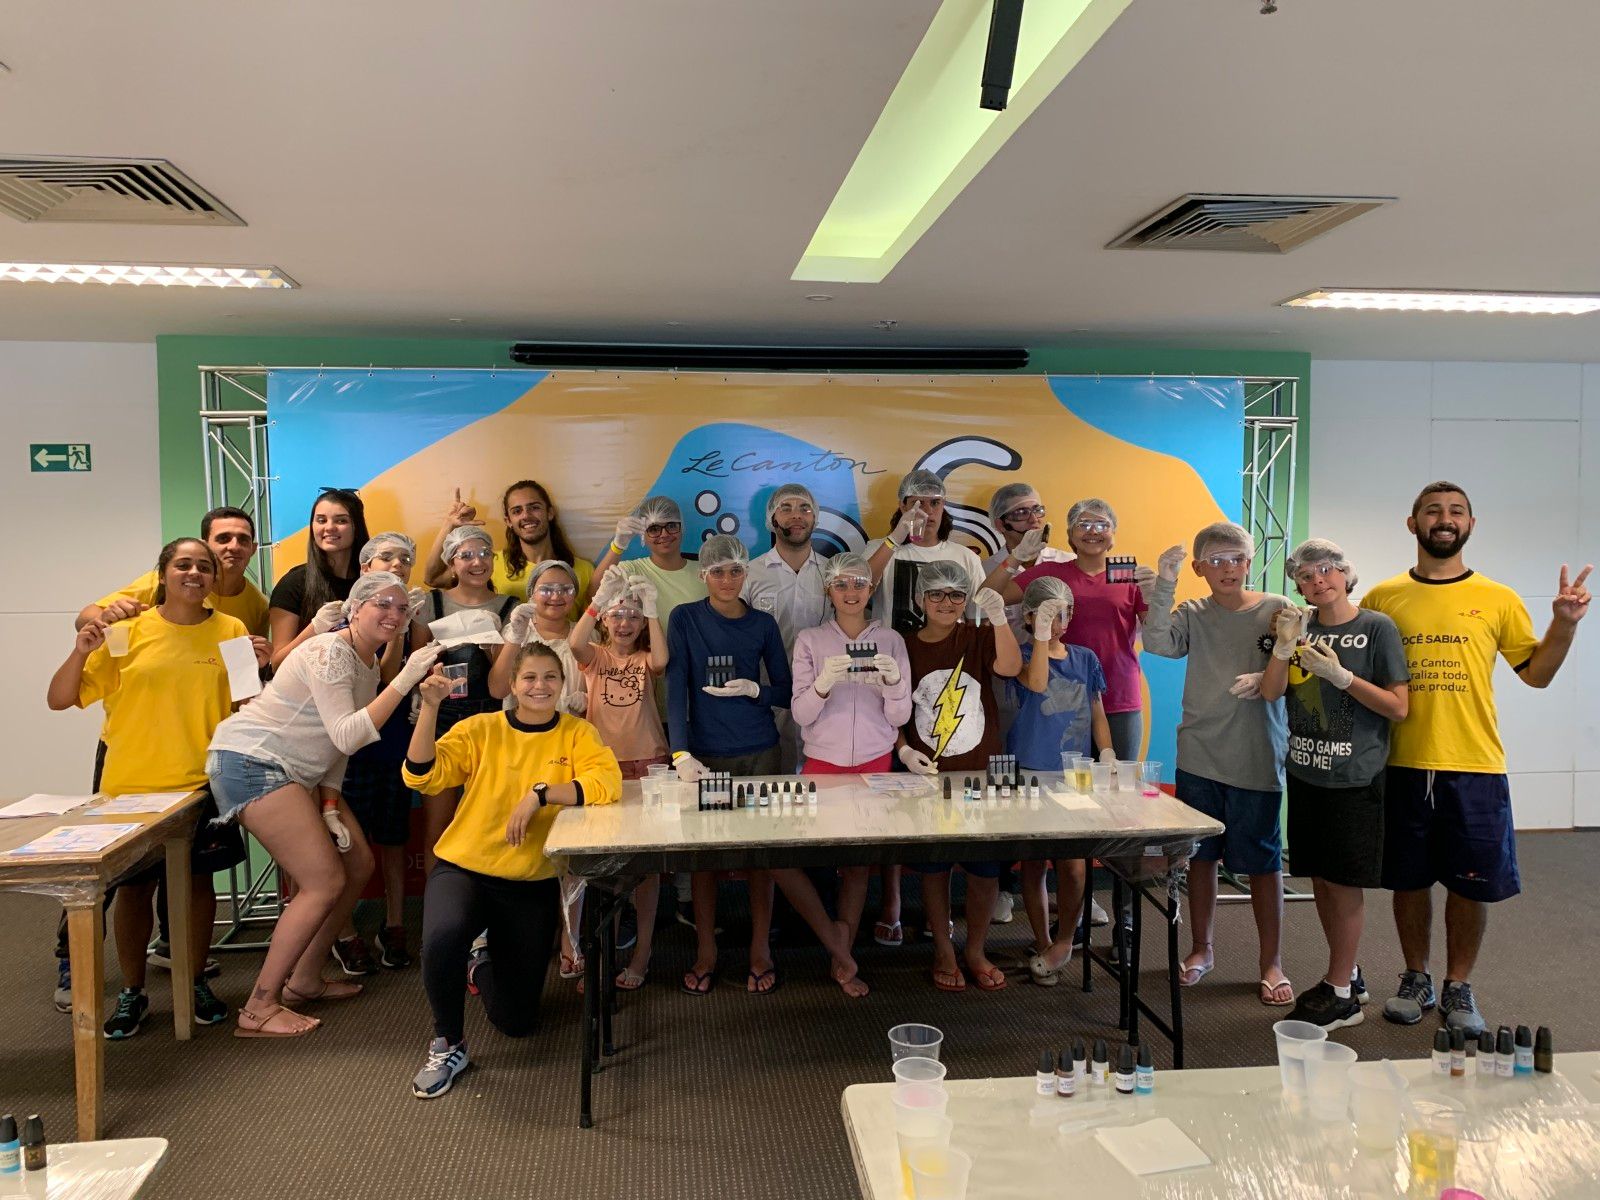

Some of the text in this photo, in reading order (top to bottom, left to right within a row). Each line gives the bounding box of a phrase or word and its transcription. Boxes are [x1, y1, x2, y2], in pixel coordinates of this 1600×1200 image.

[681, 449, 887, 478] Le Canton
[1303, 632, 1368, 649] UST GO
[1401, 633, 1469, 646] OCÊ SABIA?
[1406, 658, 1461, 668] Le Canton
[597, 666, 623, 679] Hello
[1410, 670, 1469, 681] raliza todo
[1428, 682, 1470, 693] produz.
[1316, 739, 1353, 757] GAMES
[1312, 753, 1333, 771] ME!
